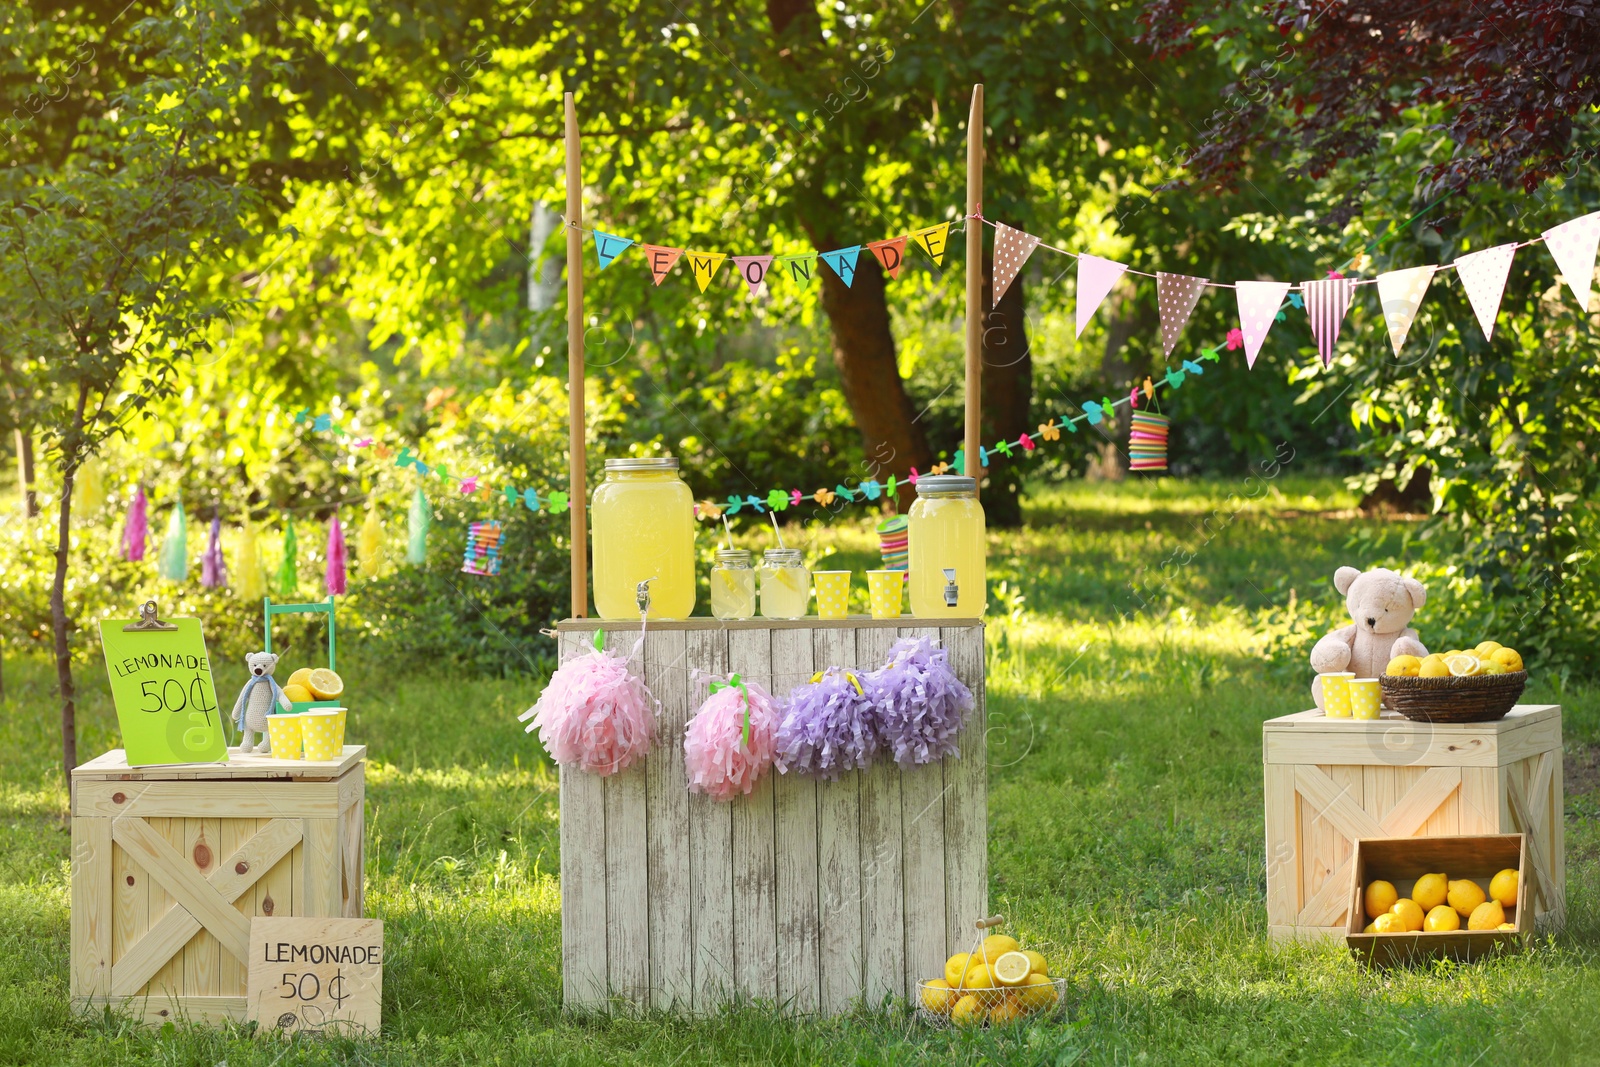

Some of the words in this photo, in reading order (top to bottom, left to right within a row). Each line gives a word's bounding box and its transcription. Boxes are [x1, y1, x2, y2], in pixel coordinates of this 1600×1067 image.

[599, 230, 944, 285] LEMONADE
[114, 653, 210, 678] LEMONADE
[264, 942, 381, 965] LEMONADE
